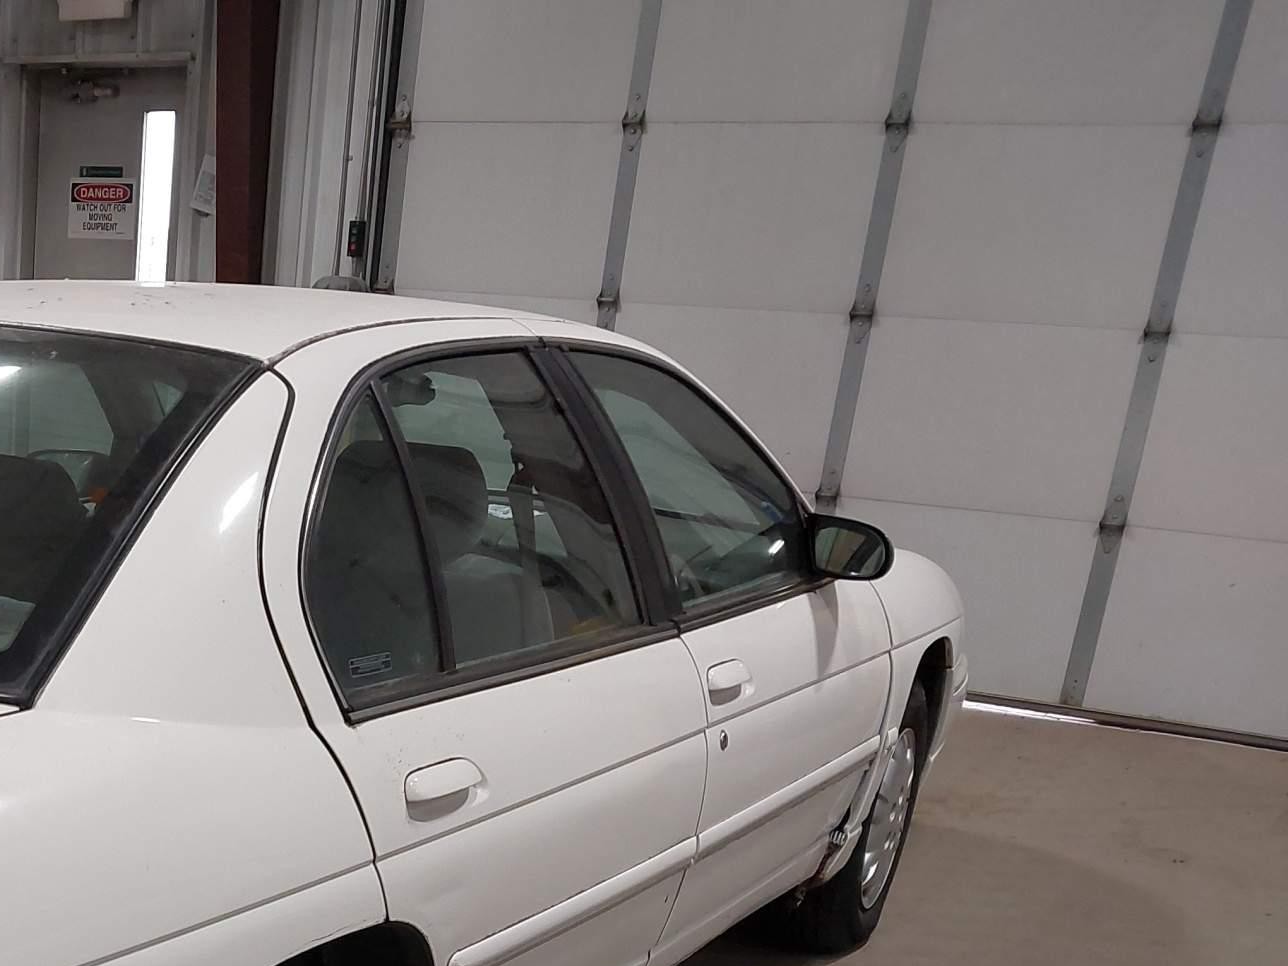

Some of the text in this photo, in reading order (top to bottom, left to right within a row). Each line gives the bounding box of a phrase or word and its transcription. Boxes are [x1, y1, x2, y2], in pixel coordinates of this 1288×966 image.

[80, 186, 124, 199] DANGER
[76, 203, 127, 213] WATCH OUT FOR
[88, 212, 113, 221] MOVING
[82, 222, 119, 231] EQUIPMENT
